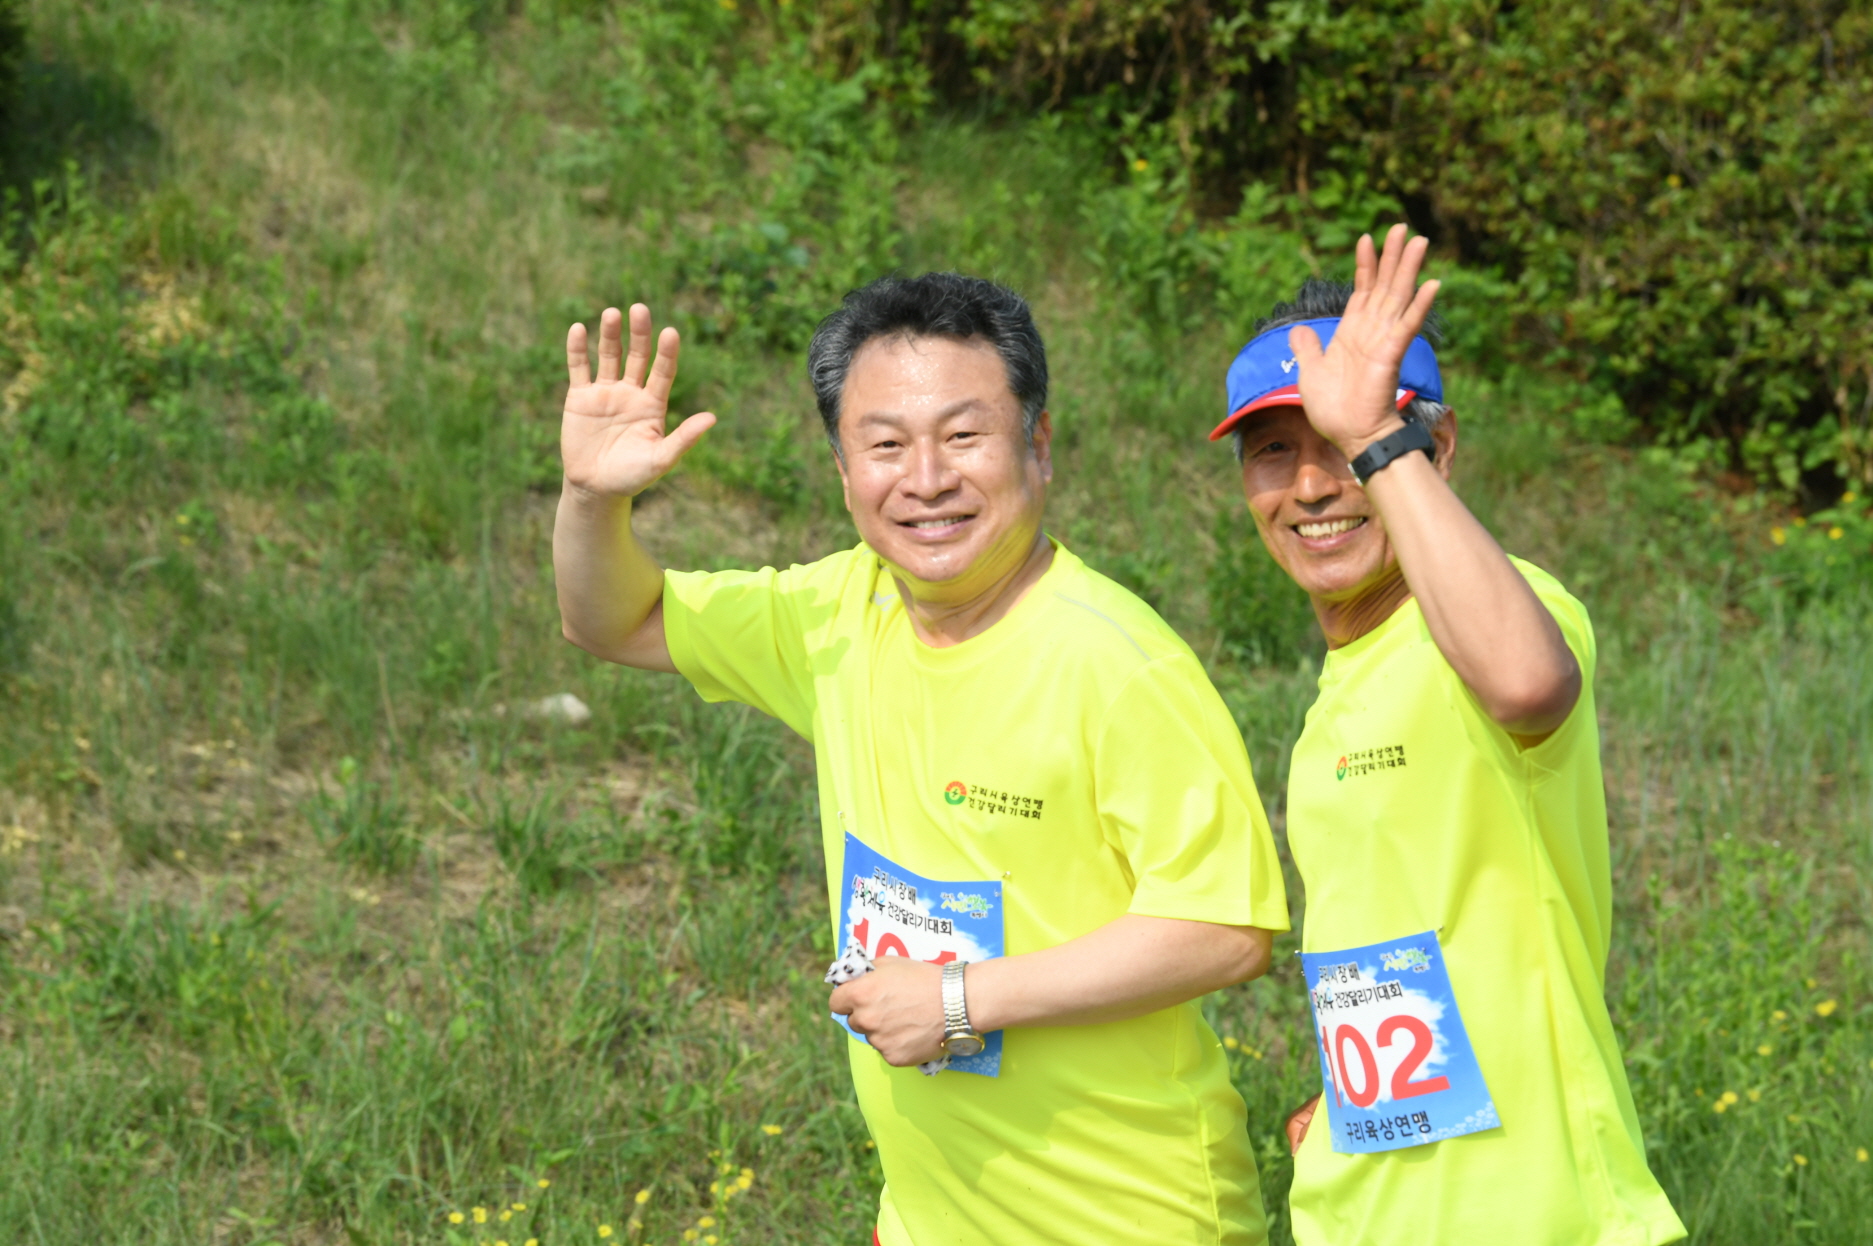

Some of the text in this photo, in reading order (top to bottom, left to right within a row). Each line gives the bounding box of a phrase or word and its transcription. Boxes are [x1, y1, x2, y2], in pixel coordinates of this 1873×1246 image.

[968, 796, 1041, 820] 건강달리기대회
[873, 867, 917, 905] 구리시장배
[887, 901, 952, 936] 건강달리기대회
[1334, 982, 1403, 1009] 건강달리기대회
[1322, 1014, 1452, 1109] 102
[1345, 1110, 1432, 1144] 구리육상연맹
